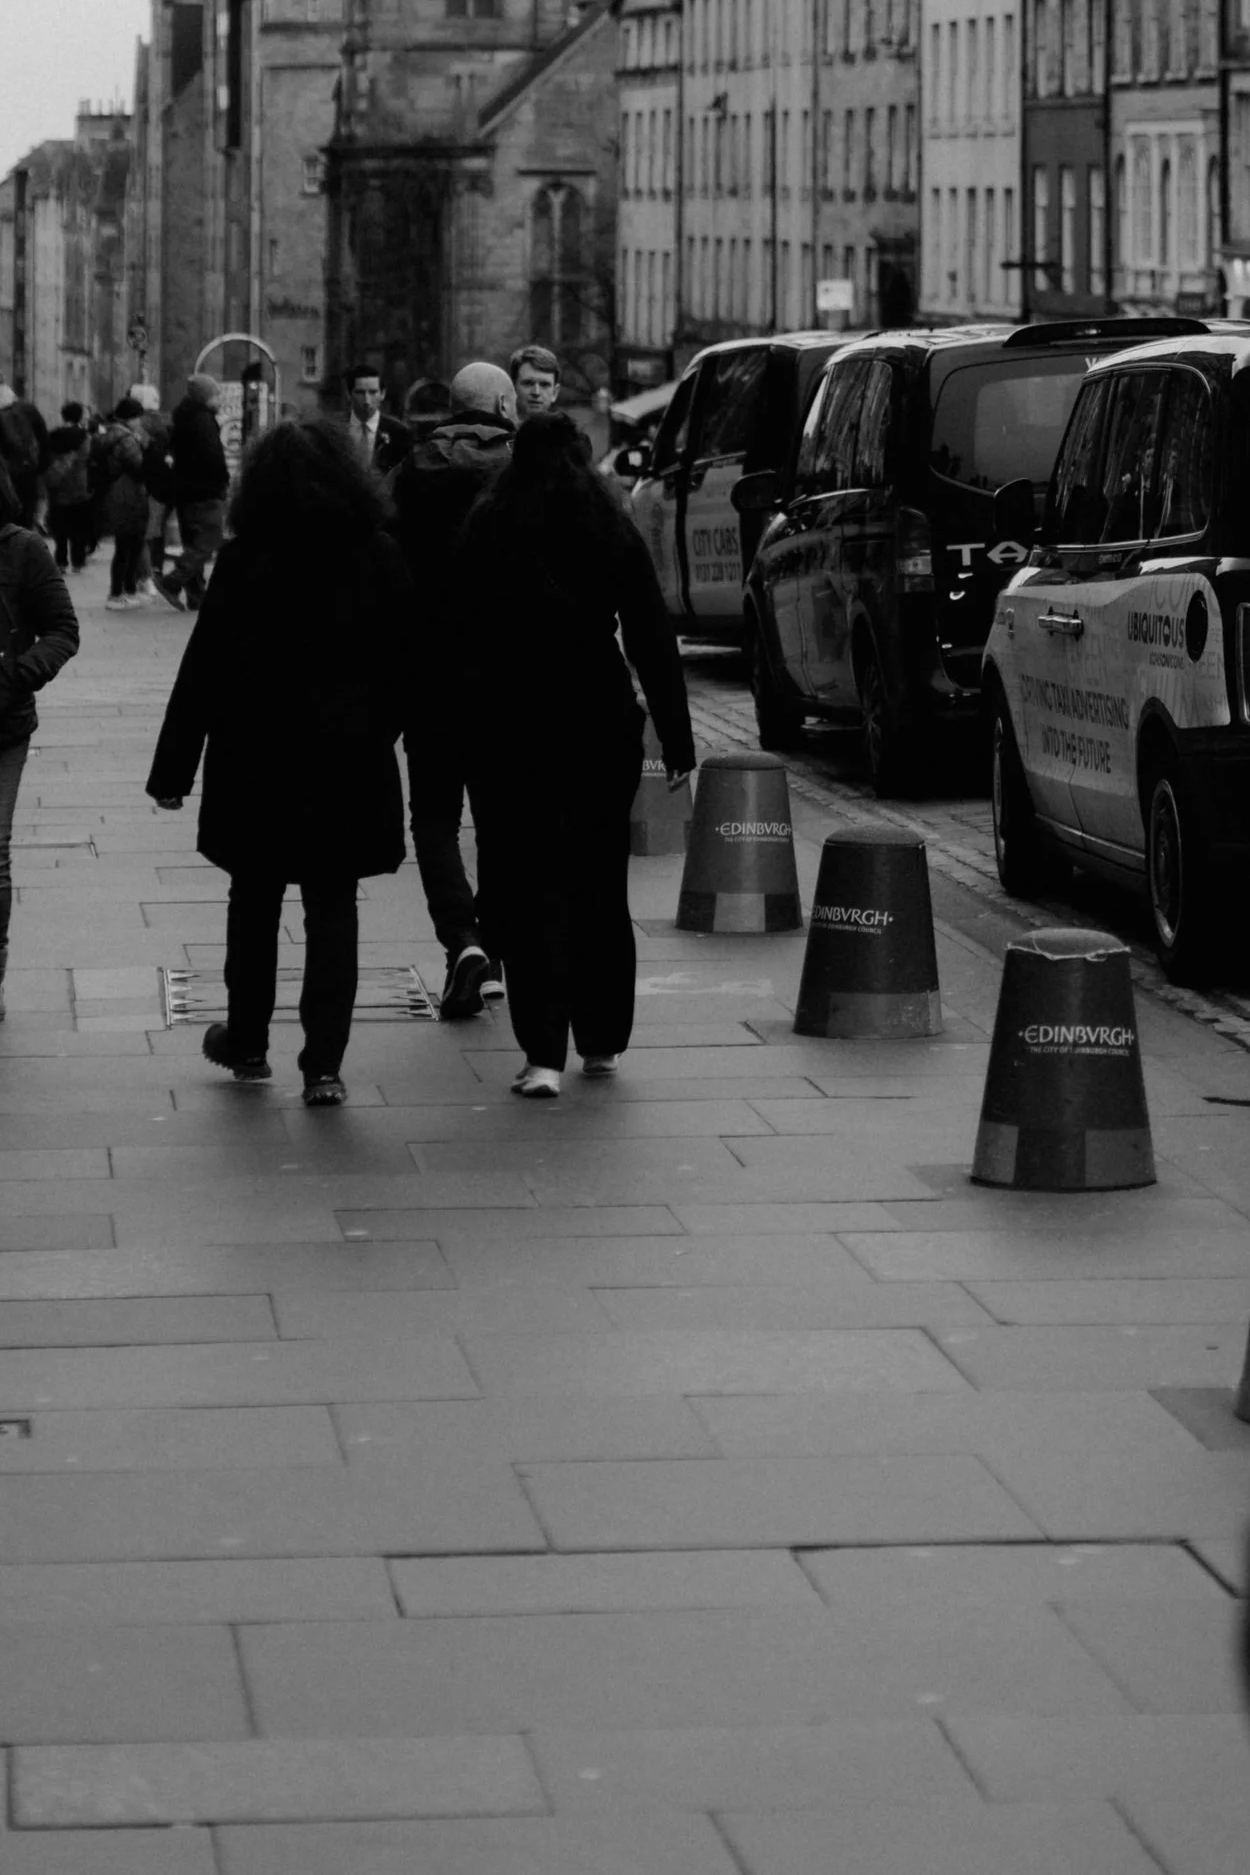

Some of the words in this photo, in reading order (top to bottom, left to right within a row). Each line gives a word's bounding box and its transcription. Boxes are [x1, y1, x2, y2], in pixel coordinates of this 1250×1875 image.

[692, 528, 711, 557] CITY
[946, 541, 1028, 566] TA
[1127, 611, 1185, 649] UBIQUITOUS
[1041, 723, 1060, 758] INTO
[1060, 729, 1077, 766] THE
[1077, 736, 1111, 774] FUTURE
